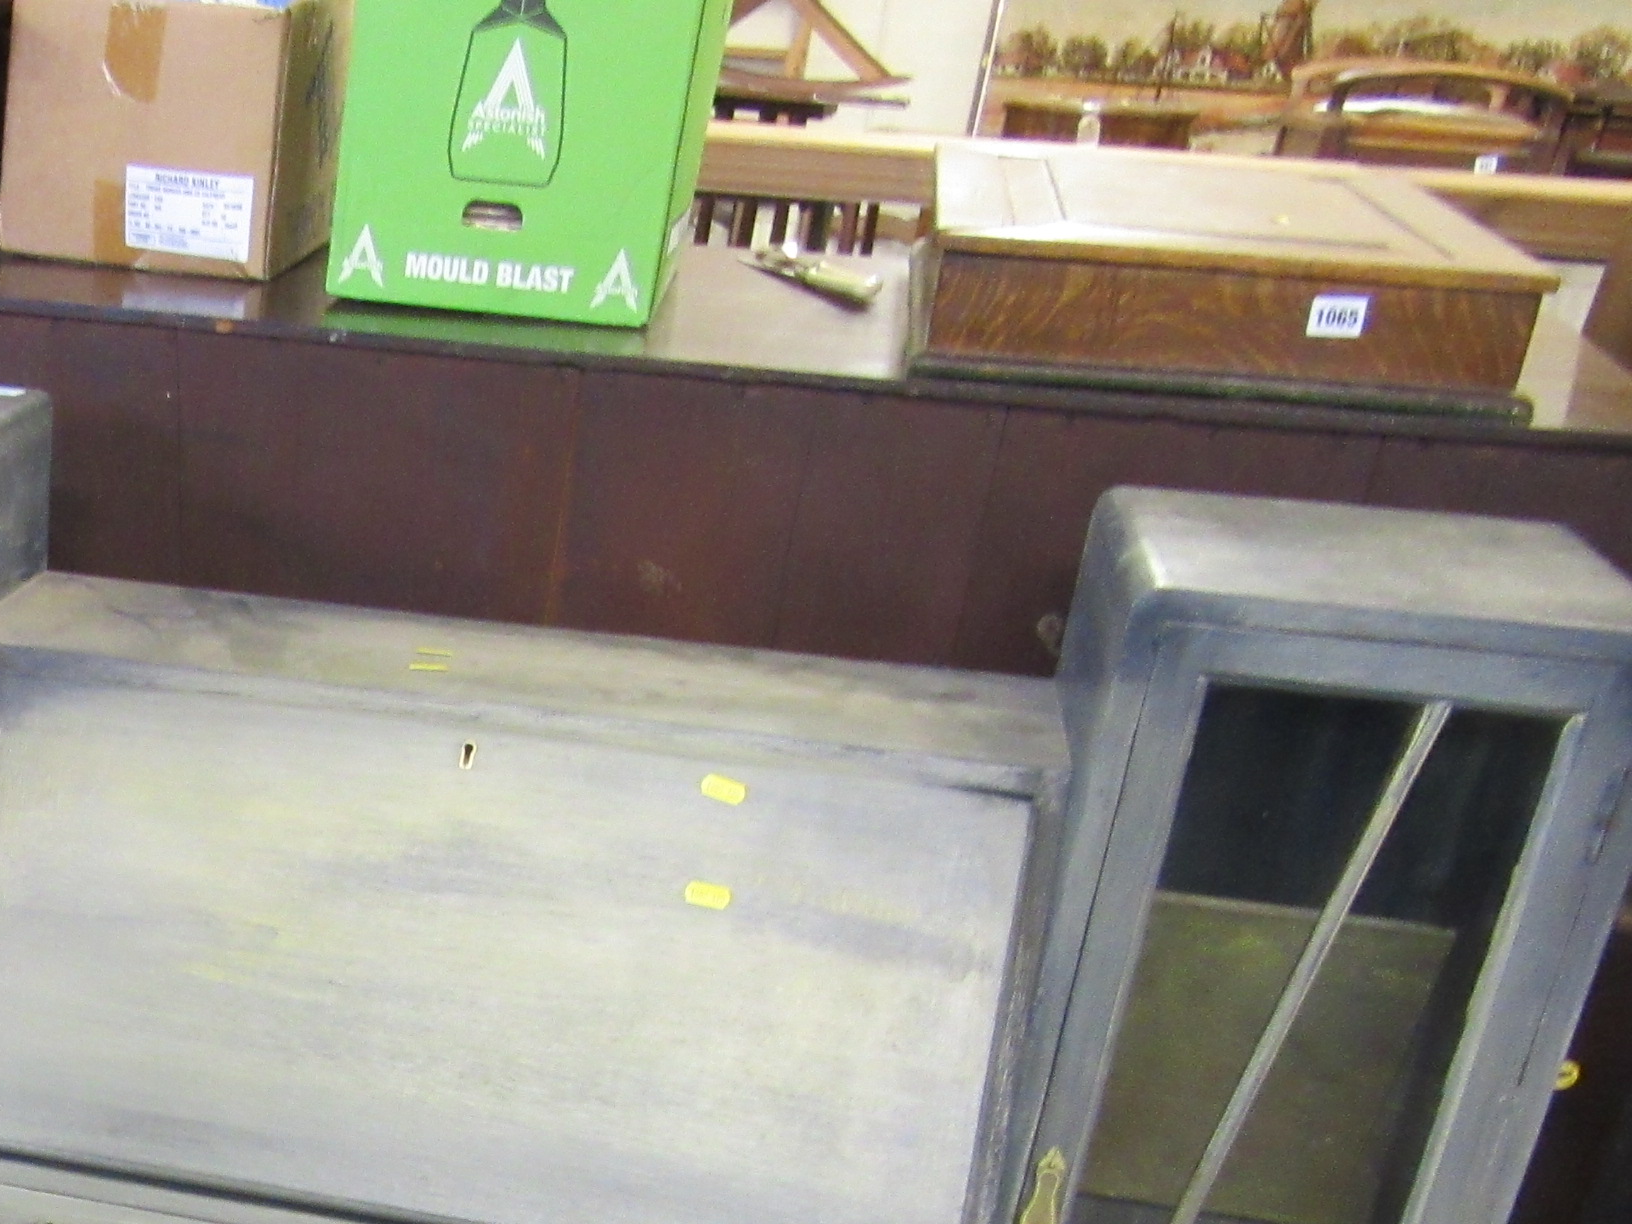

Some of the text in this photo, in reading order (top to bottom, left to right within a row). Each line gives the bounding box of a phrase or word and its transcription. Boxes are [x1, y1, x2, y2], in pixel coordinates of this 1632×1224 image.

[404, 252, 489, 285] MOULD
[496, 261, 575, 294] BLAST
[1317, 307, 1358, 327] 1065
